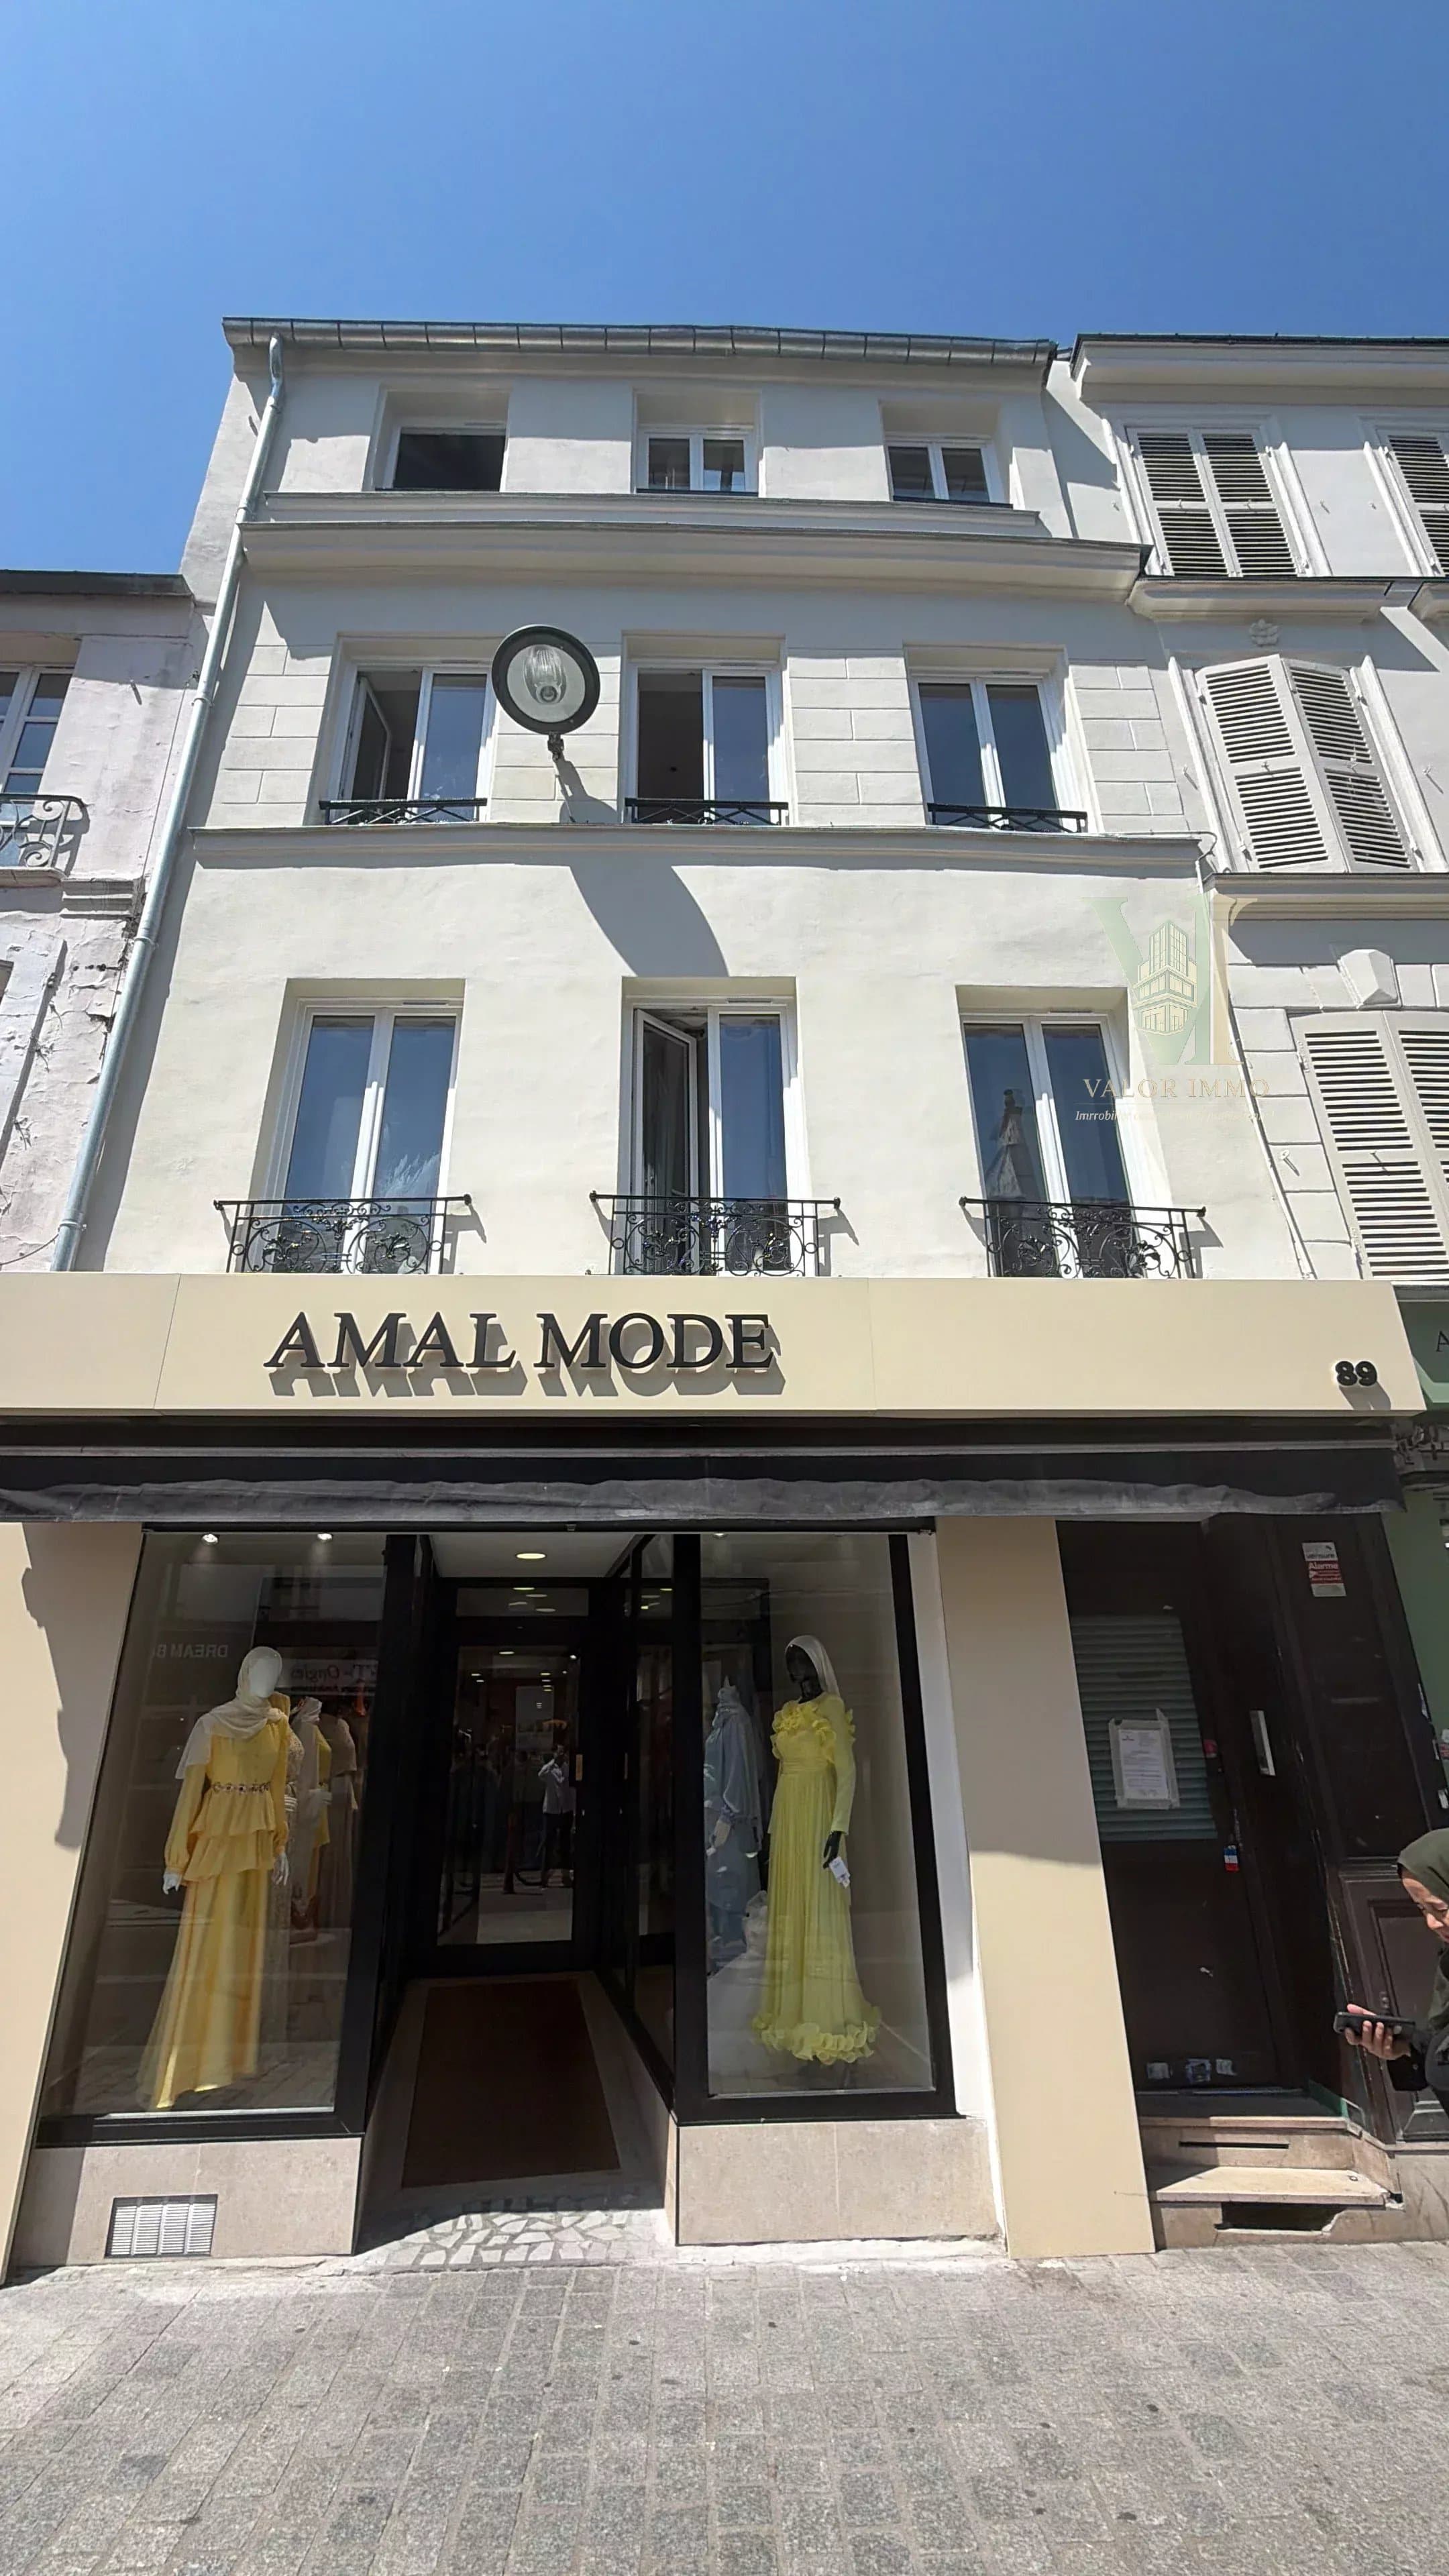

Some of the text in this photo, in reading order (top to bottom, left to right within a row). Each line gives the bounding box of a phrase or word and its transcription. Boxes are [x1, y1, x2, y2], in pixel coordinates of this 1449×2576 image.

[263, 1311, 774, 1368] AMAL MODE
[1335, 1360, 1378, 1386] 89
